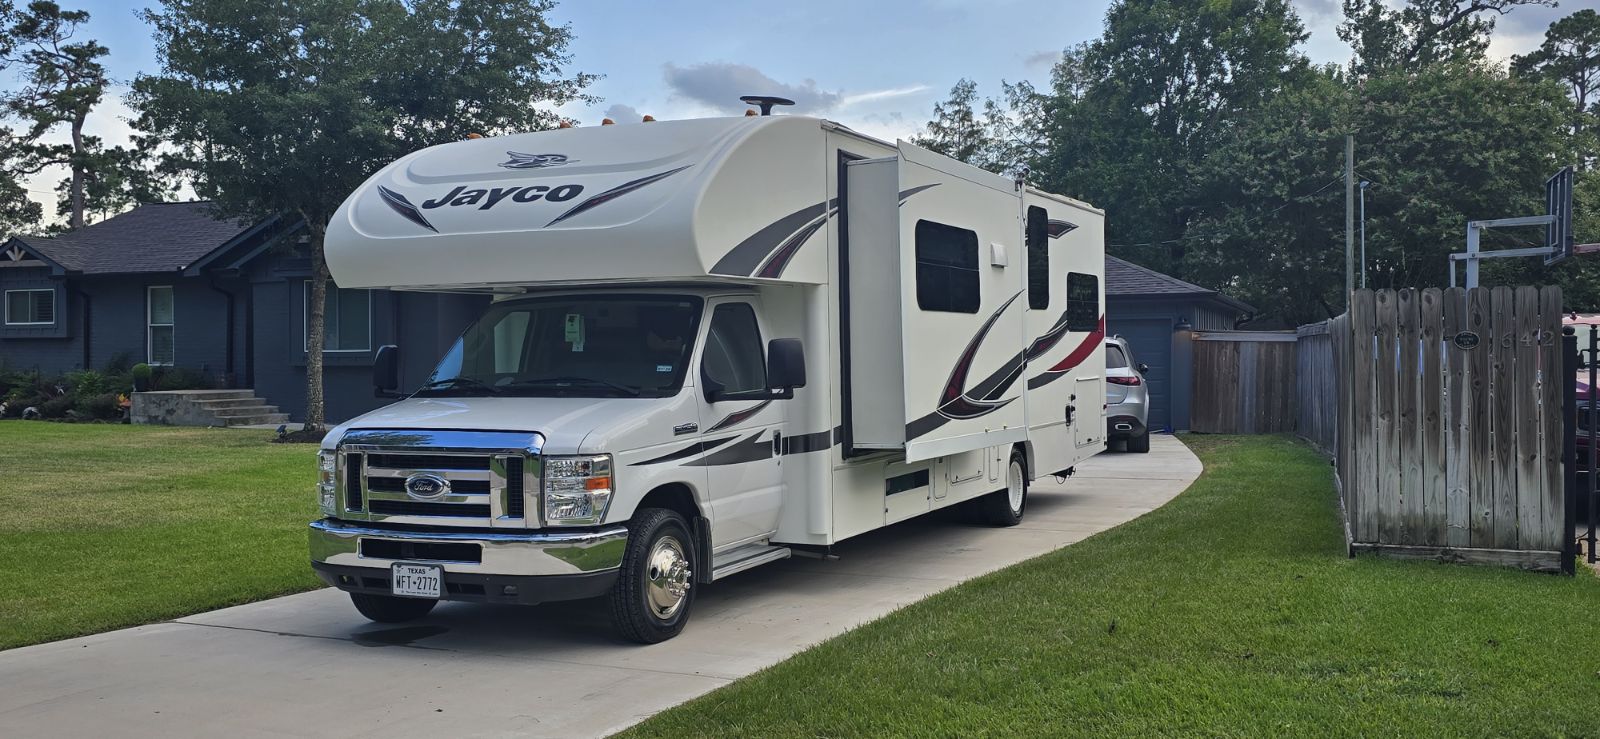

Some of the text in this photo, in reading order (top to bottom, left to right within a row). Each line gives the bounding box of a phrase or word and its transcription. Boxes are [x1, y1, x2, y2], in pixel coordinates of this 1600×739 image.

[421, 184, 585, 211] Jayco
[414, 480, 434, 491] Ford
[407, 567, 426, 575] TEXAS
